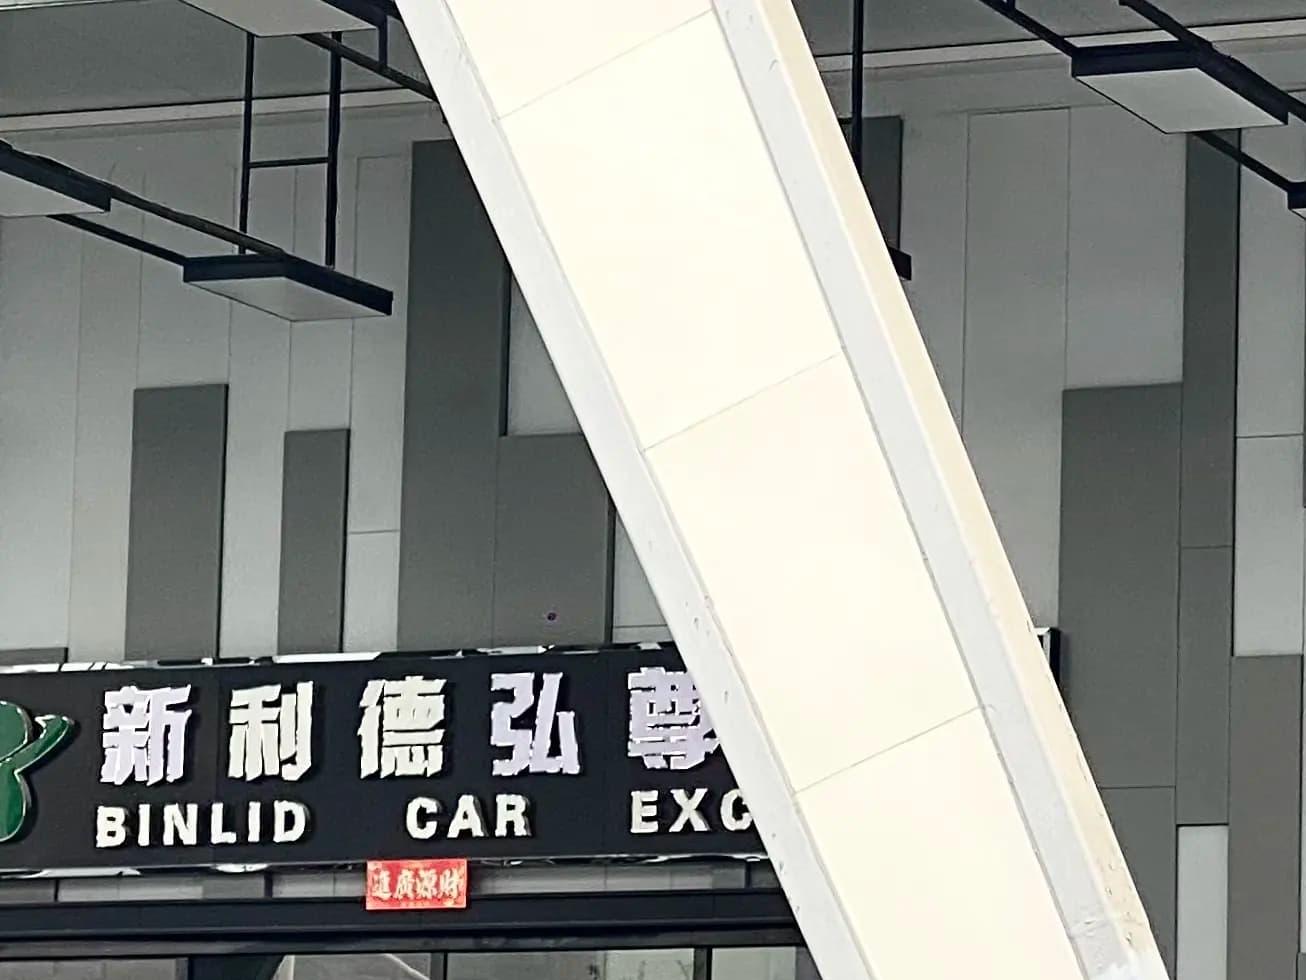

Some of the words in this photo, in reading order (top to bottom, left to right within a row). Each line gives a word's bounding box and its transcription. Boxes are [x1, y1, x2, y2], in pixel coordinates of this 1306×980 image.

[100, 667, 721, 787] 新利德弘尊
[96, 800, 309, 848] BINLID
[406, 794, 532, 839] CAR
[630, 788, 752, 834] EXC
